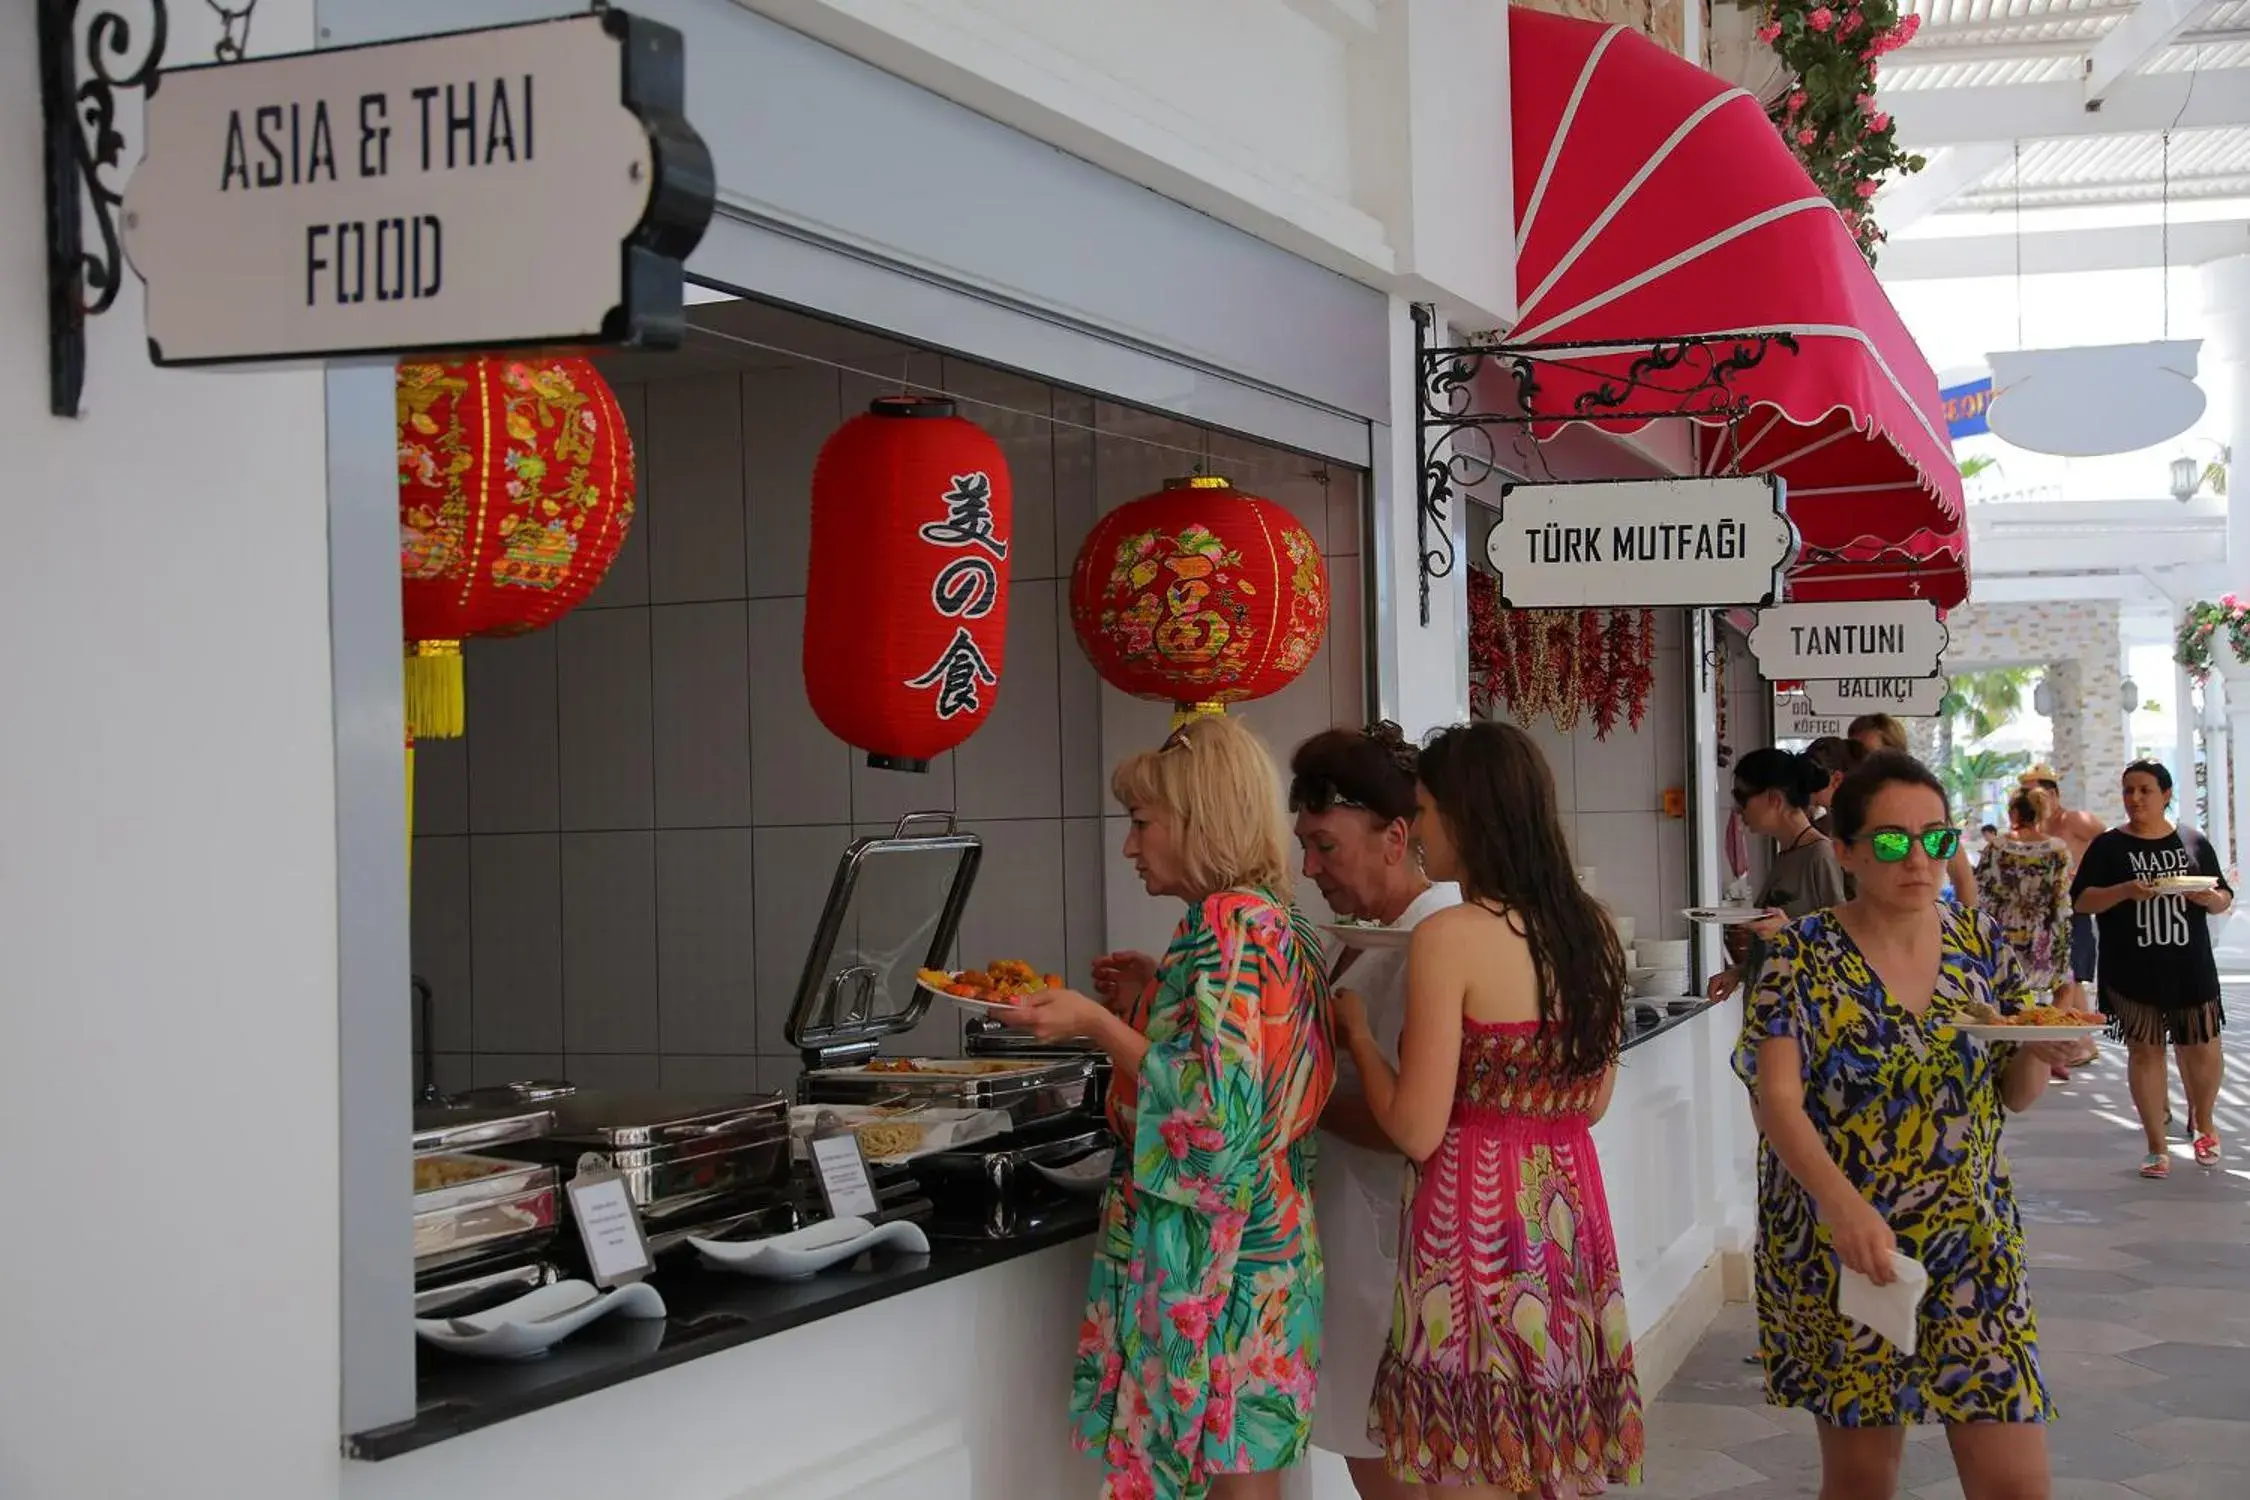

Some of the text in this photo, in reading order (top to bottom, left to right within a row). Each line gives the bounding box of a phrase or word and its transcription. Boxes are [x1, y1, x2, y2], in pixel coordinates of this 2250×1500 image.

[219, 73, 533, 191] ASIA & THAI
[306, 214, 442, 306] FOOD
[1525, 518, 1746, 563] TÜRK MUTFAĞI
[904, 471, 1008, 720] 美の食
[1790, 623, 1905, 656] TANTUNI
[1838, 679, 1913, 702] BALIKÇI
[2127, 848, 2189, 872] MADE
